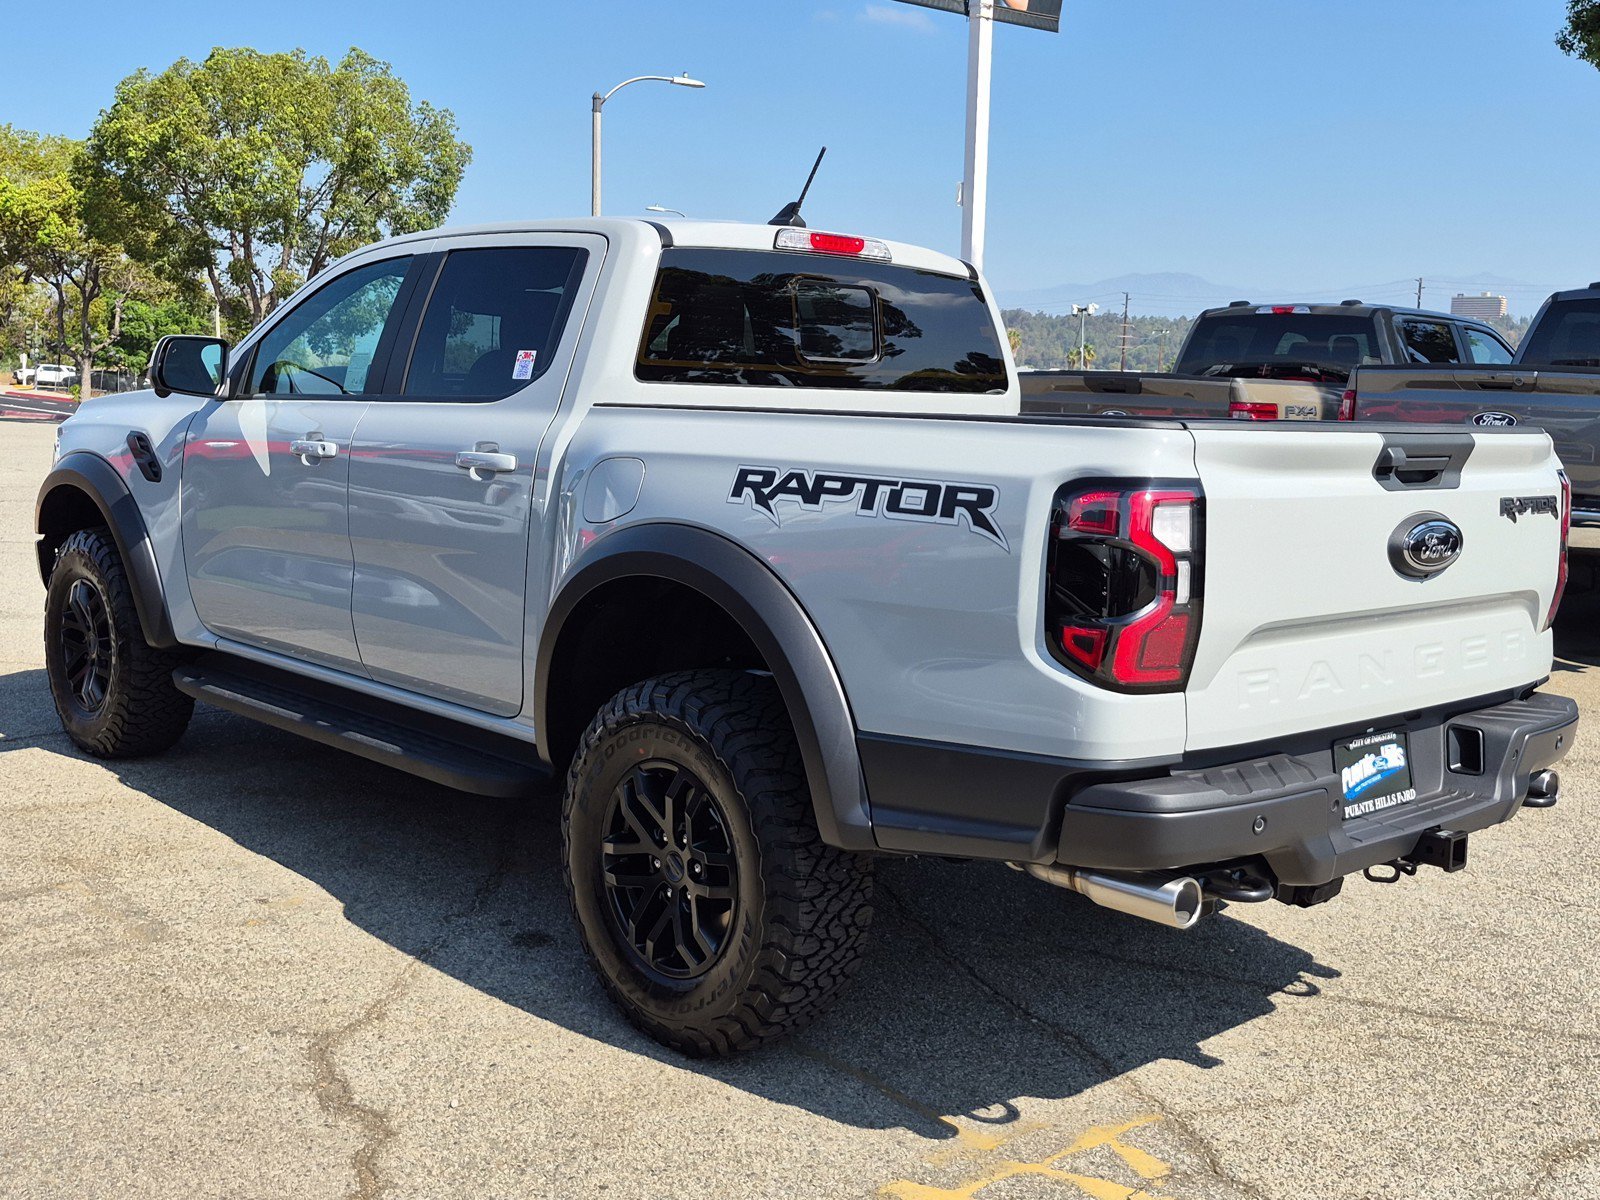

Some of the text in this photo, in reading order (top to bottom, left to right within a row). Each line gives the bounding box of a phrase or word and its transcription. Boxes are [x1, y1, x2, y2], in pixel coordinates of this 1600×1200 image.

[1285, 405, 1317, 418] FX4
[727, 465, 1009, 552] RAPTOR
[1499, 495, 1559, 523] RAPTOR
[1421, 532, 1456, 559] Ford
[1237, 627, 1527, 710] RANGER
[1344, 800, 1375, 818] PUENTE
[1375, 793, 1396, 810] HILLS
